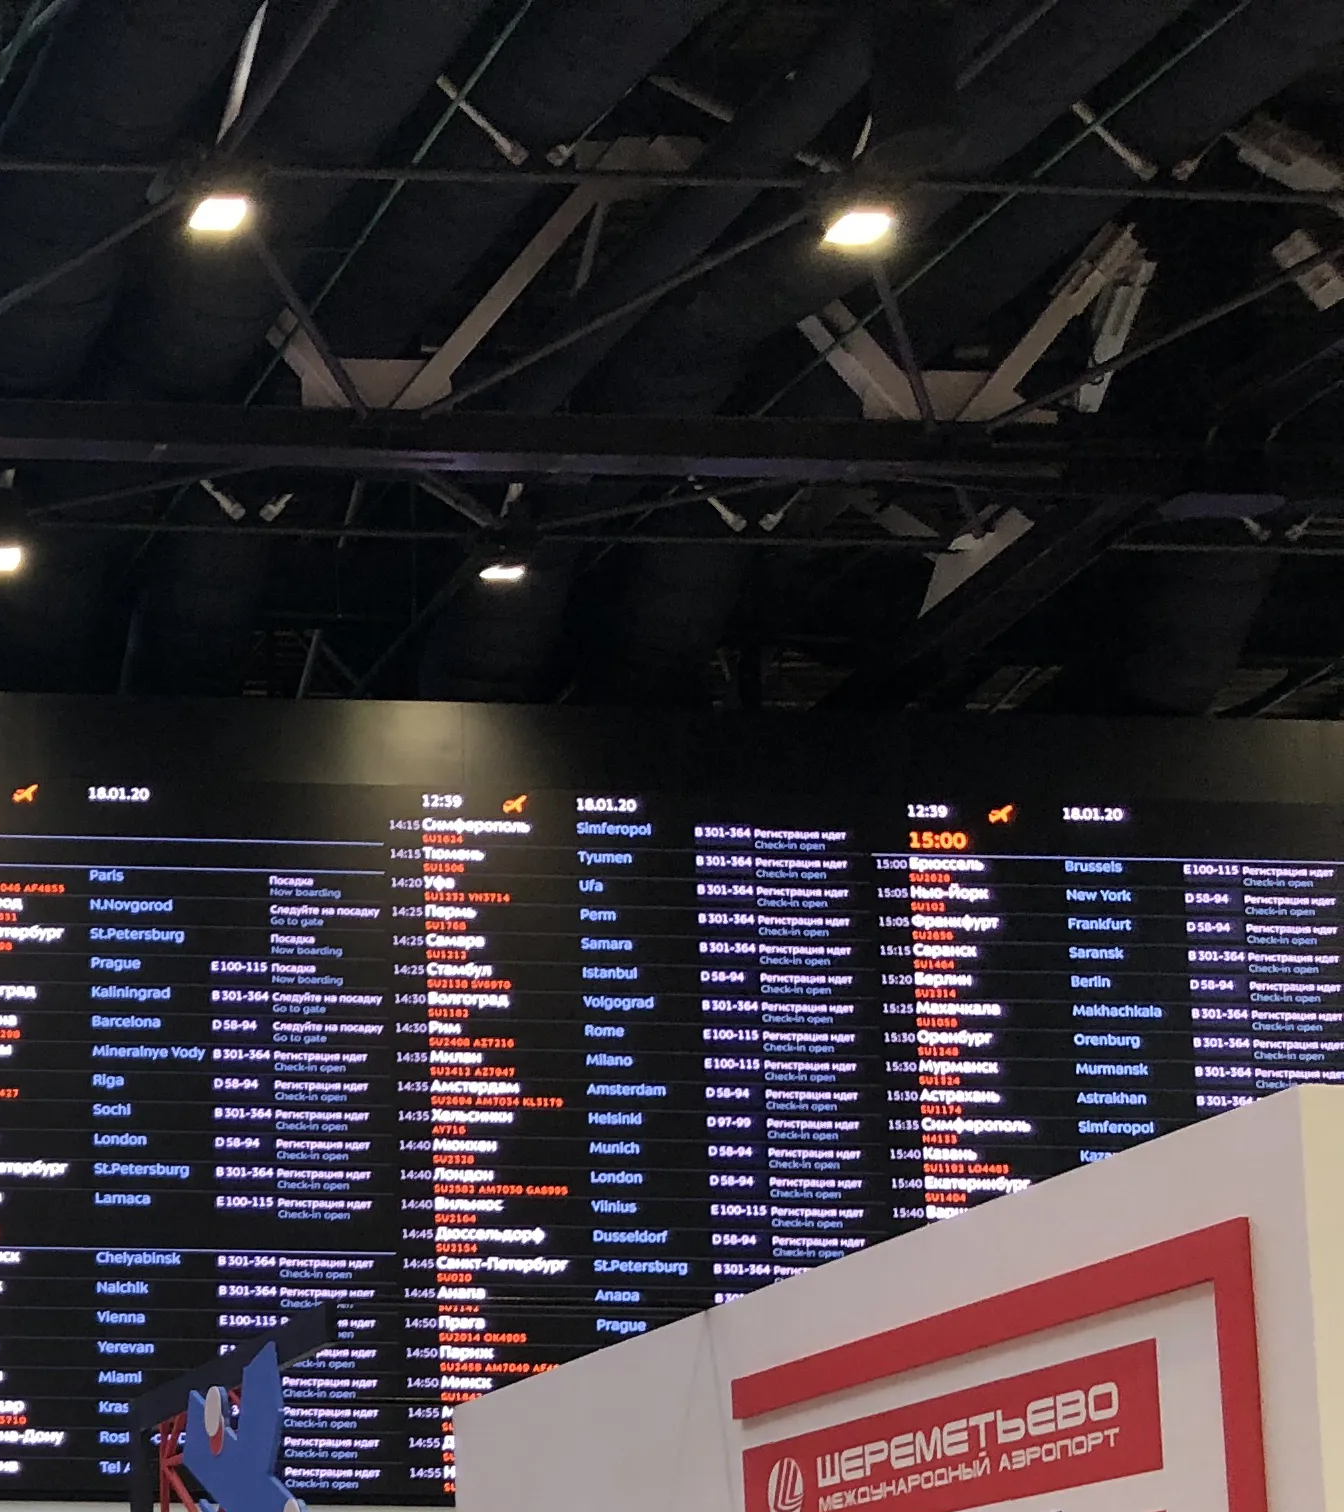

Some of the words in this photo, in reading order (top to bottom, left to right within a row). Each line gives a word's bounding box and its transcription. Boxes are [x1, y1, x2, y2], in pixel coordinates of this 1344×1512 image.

[88, 787, 149, 800] 18.01.20
[422, 795, 462, 808] 12:39
[576, 799, 636, 812] 18.01.20
[908, 805, 947, 818] 12:39
[1063, 808, 1123, 821] 18.01.20
[909, 832, 966, 849] 15:00
[577, 852, 632, 865] Tyumen
[270, 876, 313, 887] Посадка
[270, 888, 292, 898] Now
[295, 888, 340, 899] boarding
[90, 898, 173, 913] N.Novgorod
[580, 909, 616, 922] Perm
[581, 938, 632, 951] Samara
[427, 963, 492, 978] Стамбул
[582, 967, 637, 980] Istanbul
[92, 985, 170, 1001] Kaliningrad
[583, 996, 654, 1010] Volgograd
[92, 1015, 160, 1029] Barcelona
[587, 1084, 666, 1097] Amsterdam
[94, 1133, 147, 1146] London
[589, 1141, 639, 1155] Munich
[95, 1192, 151, 1205] Larnaca
[592, 1200, 637, 1213] Vilnius
[593, 1229, 668, 1243] Dusseldorf
[97, 1281, 148, 1294] Nalchik
[98, 1371, 142, 1383] Miami
[816, 1382, 1119, 1488] ШЕРЕМЕТЬЕВО
[818, 1453, 991, 1512] МЕЖДУНАРОДНЫЙ
[998, 1428, 1120, 1473] АЭРОПОРТ
